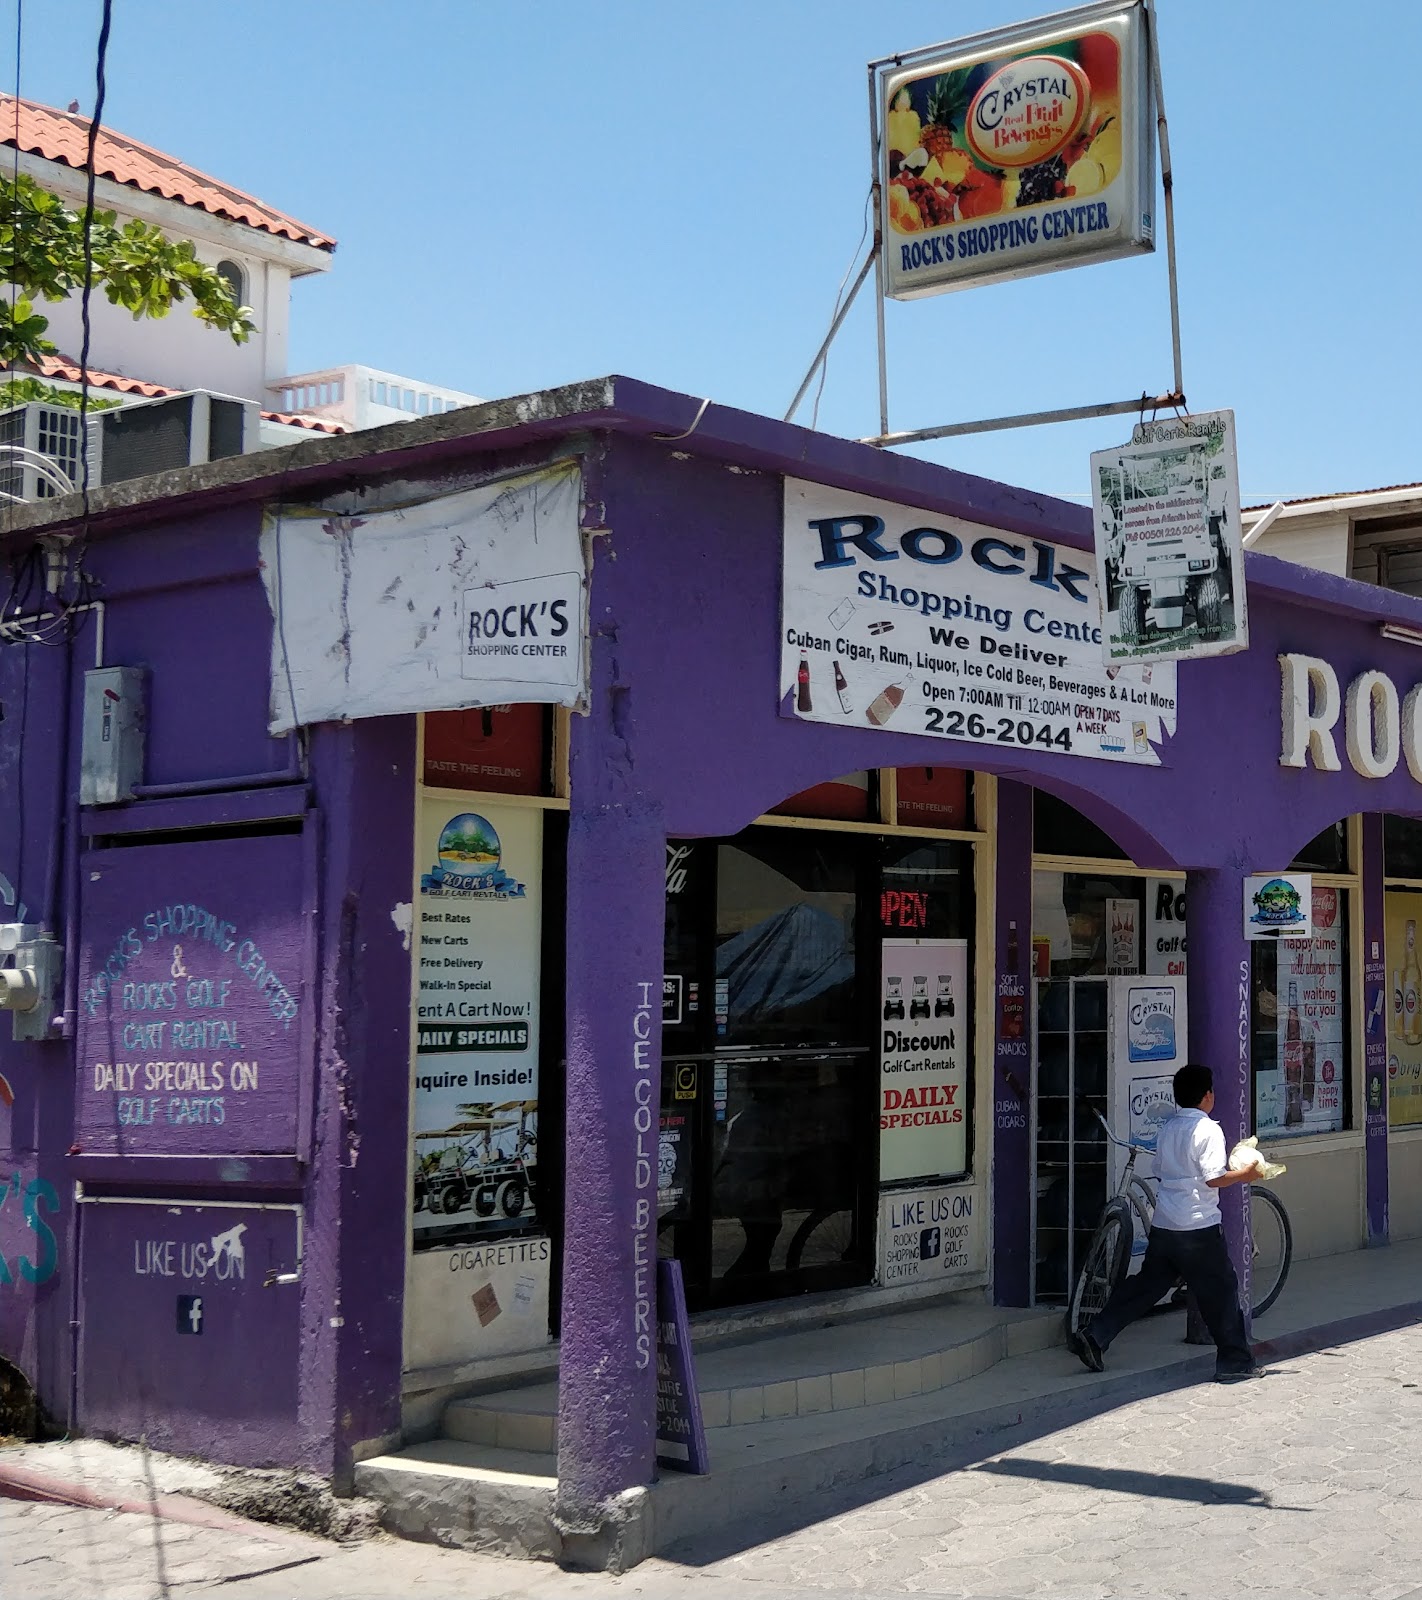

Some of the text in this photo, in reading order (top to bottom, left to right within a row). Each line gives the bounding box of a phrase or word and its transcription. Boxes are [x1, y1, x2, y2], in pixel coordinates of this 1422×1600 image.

[976, 77, 1071, 131] CRYSTAL
[1004, 99, 1063, 126] Real Fruit
[901, 201, 1109, 271] ROCK'S SHOPPING CENTER
[1186, 417, 1227, 437] Rentals
[1165, 527, 1182, 538] 226
[858, 570, 1102, 645] Shopping Cente
[469, 600, 569, 639] ROCK'S
[468, 645, 568, 656] SHOPPING CENTER
[929, 626, 1067, 668] We Deliver
[787, 628, 1175, 709] Cuban Cigar, Rum, Liquor, Ice Cold Beer, Beverages & A Lot More
[923, 681, 1071, 716] Open 7:00AM Til 12:00AM
[1074, 704, 1121, 723] OPEN 7 DAYS
[924, 707, 1072, 751] 226-2044
[1076, 721, 1107, 735] A WEEK
[427, 760, 521, 778] TASTE THE FEELING
[912, 802, 953, 813] THE FEELING
[473, 891, 507, 899] RENTALS
[421, 913, 471, 923] Best Rates
[144, 904, 237, 952] SHOPPING
[421, 936, 469, 945] New Carts
[1157, 937, 1179, 952] Golf
[1315, 937, 1337, 950] time
[171, 944, 187, 978] &
[420, 958, 483, 969] Free Delivery
[1168, 961, 1185, 975] Call
[420, 981, 492, 992] Walk-In Special
[1001, 974, 1019, 986] SOFT
[186, 979, 231, 1008] GOLF
[999, 984, 1025, 997] DRINKS
[1303, 987, 1336, 1003] waiting
[418, 1002, 488, 1017] ent A Cart
[1130, 1003, 1173, 1025] CRYSTAL
[1305, 1004, 1336, 1018] for you
[633, 982, 653, 1070] ICE
[1238, 960, 1249, 1083] SNACKS
[123, 1022, 167, 1051] CART
[418, 1030, 527, 1046] AILY SPECIALS
[884, 1028, 955, 1053] Discount
[997, 1043, 1027, 1056] SNACKS
[883, 1057, 955, 1073] Golf Cart Rentals
[95, 1061, 258, 1092] DAILY SPECIALS ON
[474, 1068, 533, 1087] Inside!
[883, 1085, 958, 1110] DAILY
[1318, 1085, 1338, 1098] happy
[118, 1096, 226, 1126] GOLF CARTS
[996, 1101, 1021, 1113] CUBAN
[1131, 1091, 1174, 1115] CRYSTAL
[1318, 1097, 1338, 1109] time
[880, 1109, 962, 1129] SPECIALS
[997, 1115, 1026, 1129] CIGARS
[633, 1078, 653, 1189] COLD
[892, 1195, 972, 1228] LIKE US ON
[449, 1241, 549, 1272] CIGARETTES
[945, 1240, 964, 1254] GOLF
[134, 1240, 176, 1276] LIKE
[181, 1242, 208, 1279] US
[944, 1254, 969, 1269] CARTS
[887, 1262, 919, 1279] CENTER
[632, 1199, 653, 1369] BEERS
